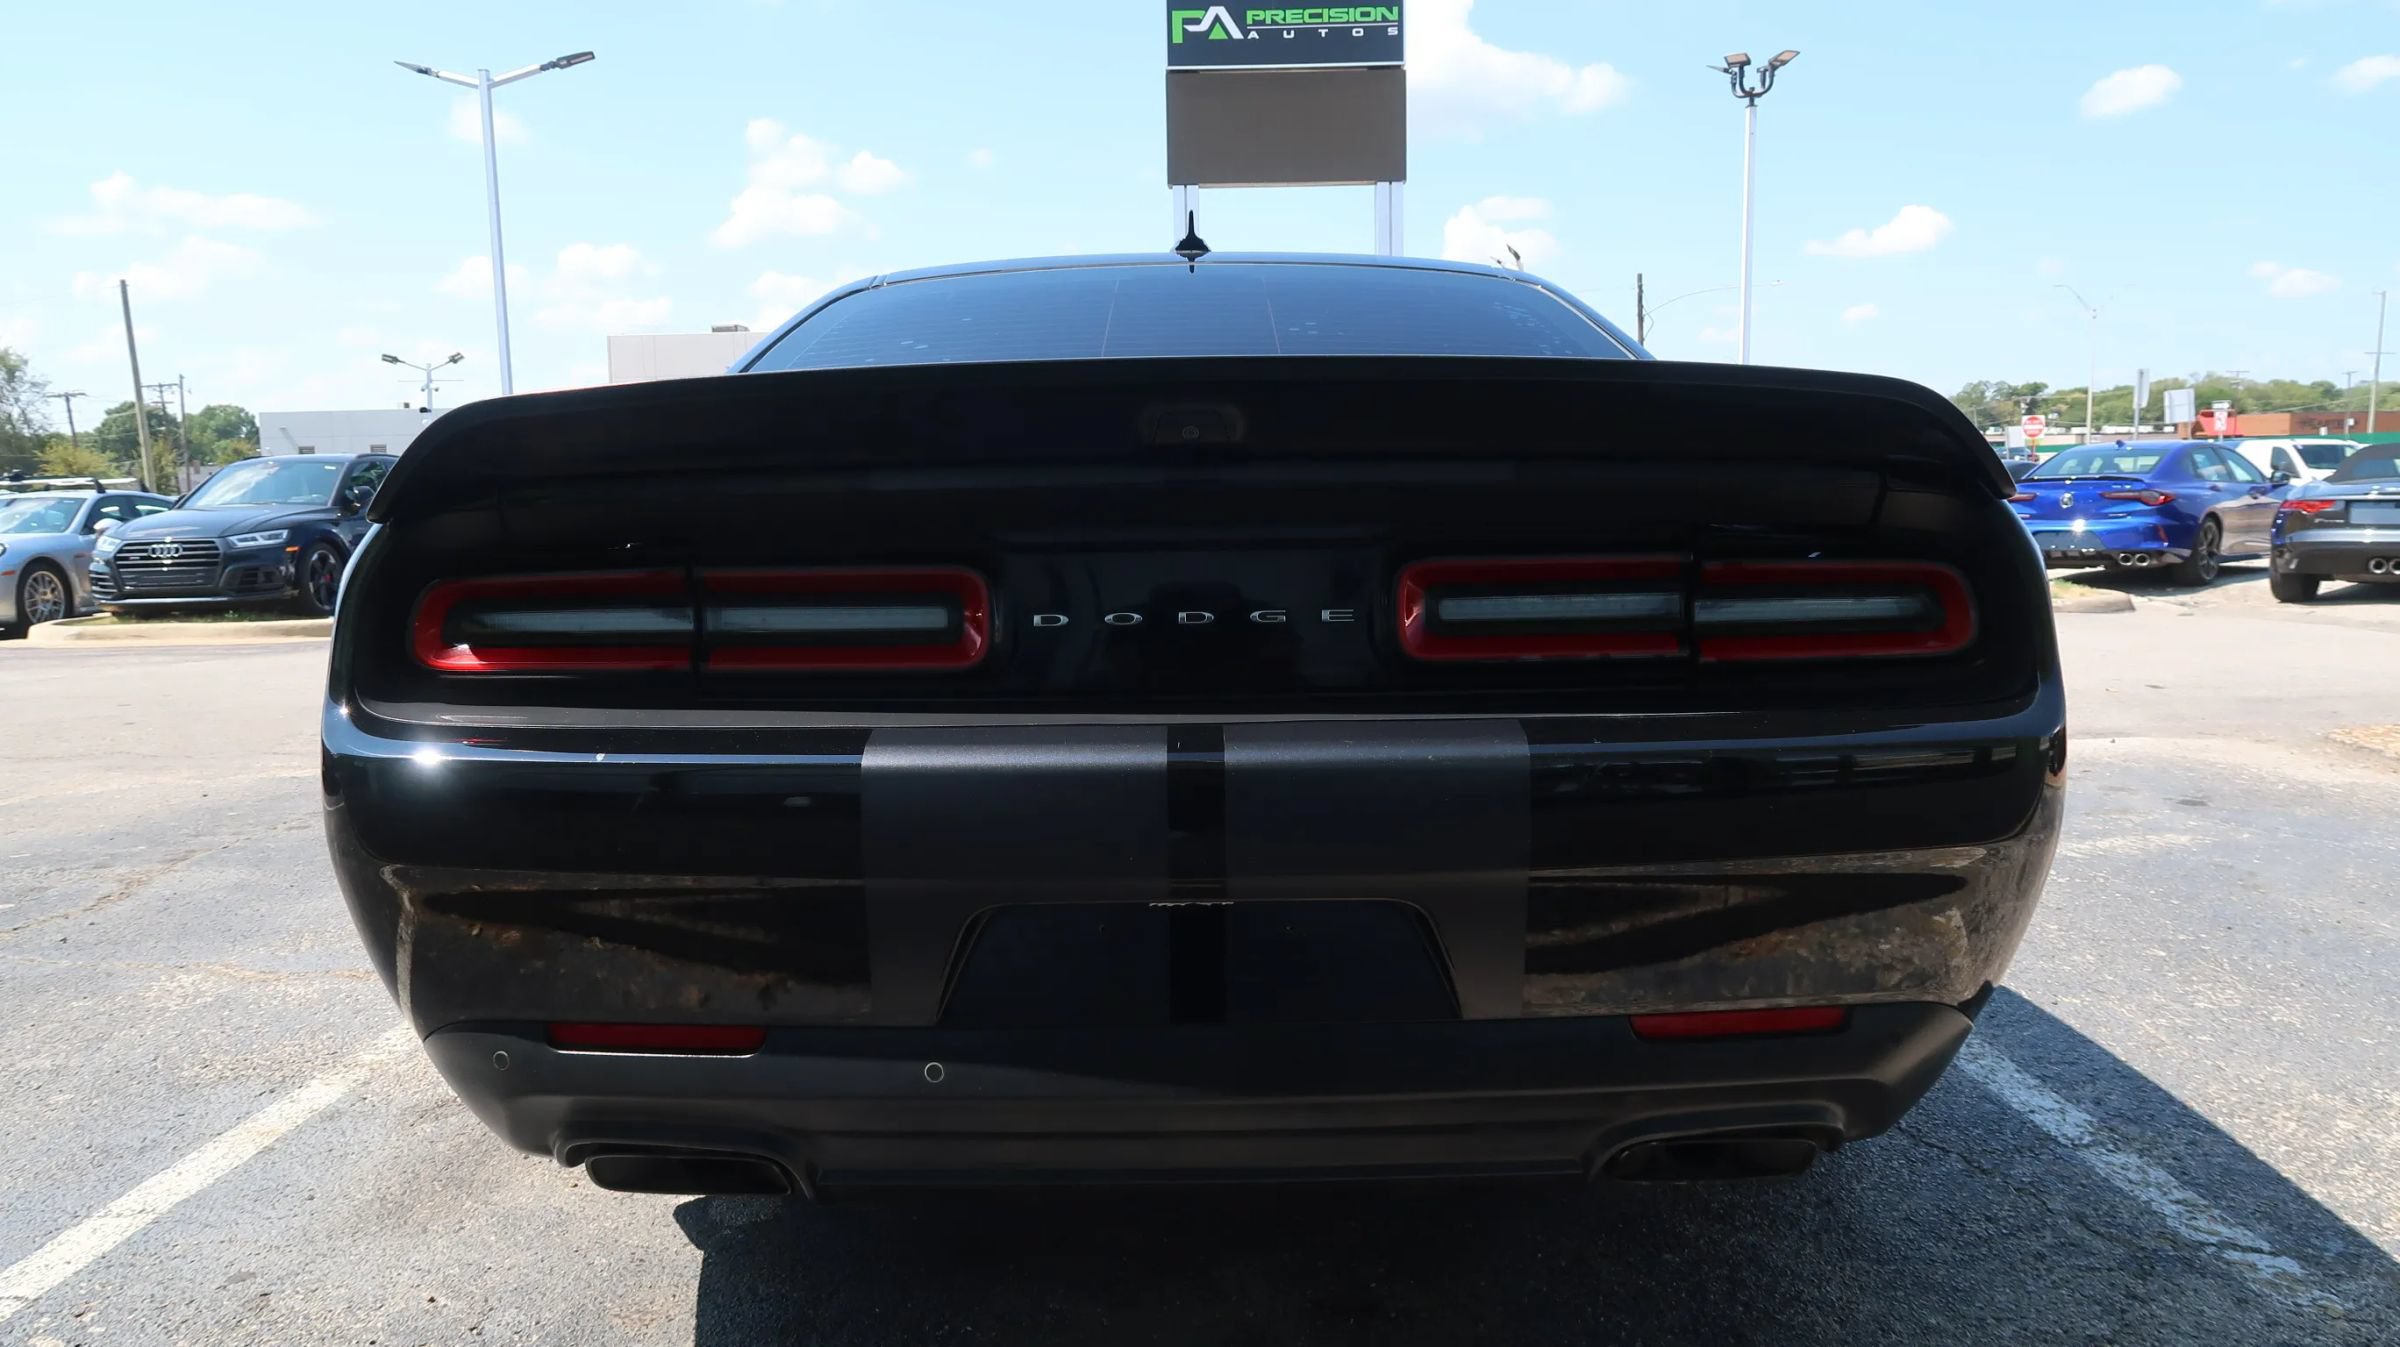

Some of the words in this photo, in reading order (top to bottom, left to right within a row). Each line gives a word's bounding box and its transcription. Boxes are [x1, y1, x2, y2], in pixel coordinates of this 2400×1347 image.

[1247, 6, 1398, 24] PRECISION
[1247, 27, 1398, 39] AUTOS
[1033, 609, 1355, 627] DODGE
